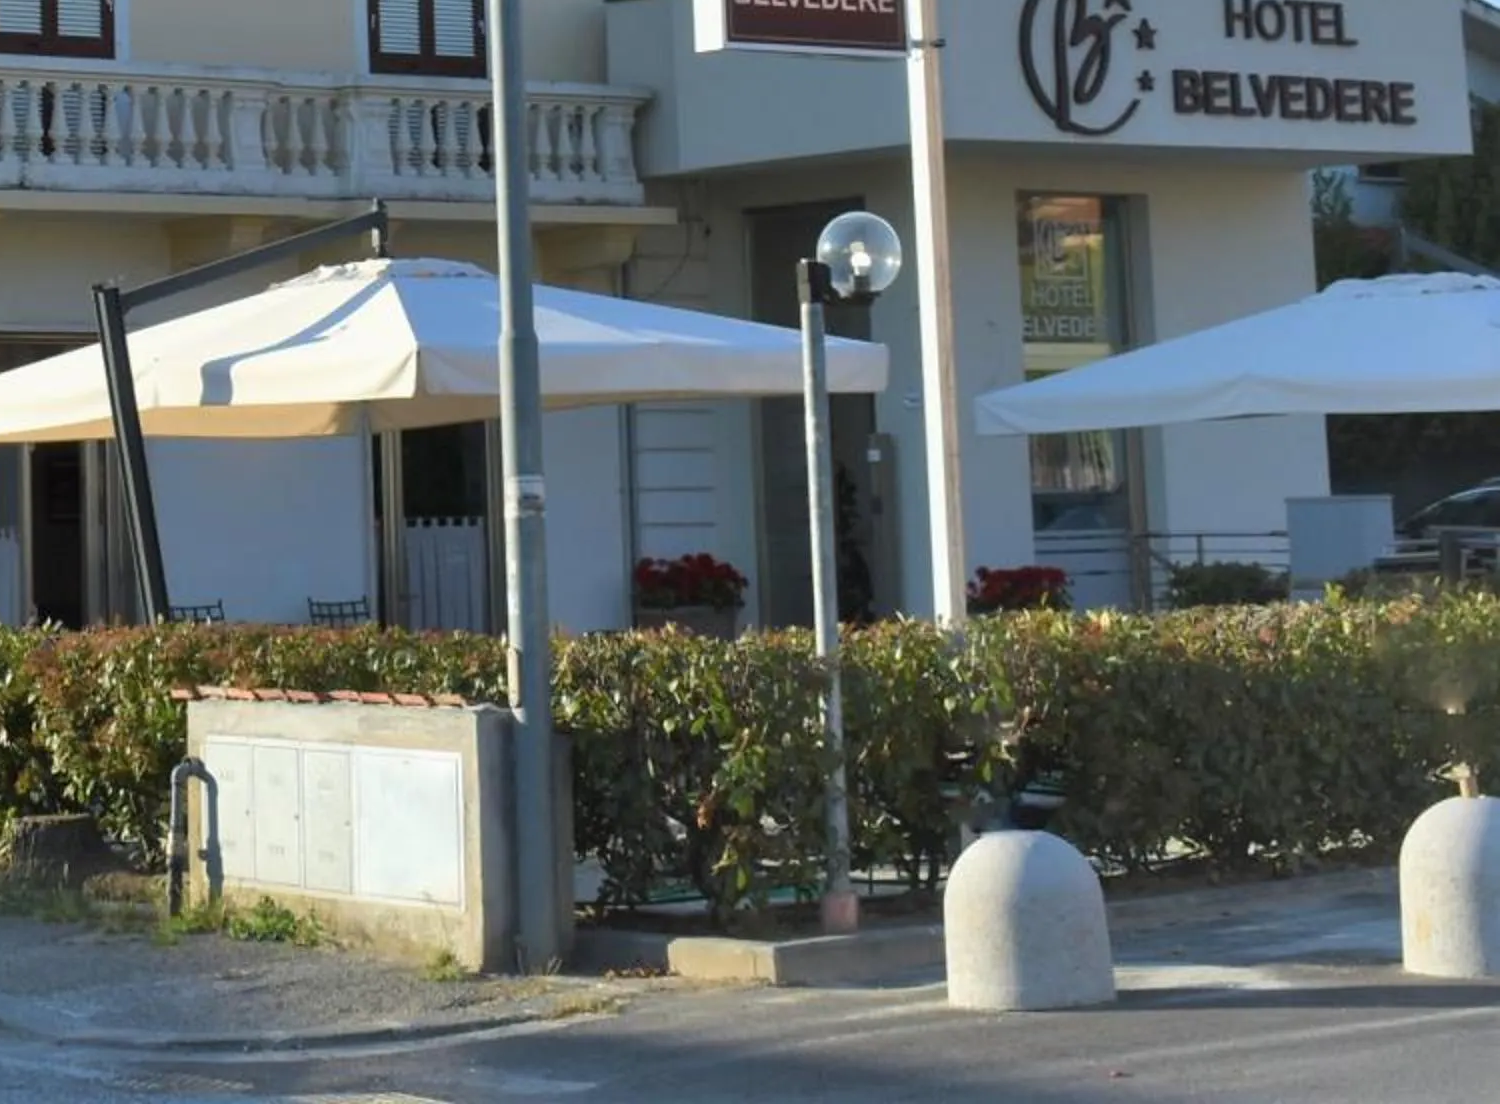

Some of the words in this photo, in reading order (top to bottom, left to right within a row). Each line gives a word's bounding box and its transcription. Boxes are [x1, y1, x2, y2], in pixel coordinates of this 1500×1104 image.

[1171, 68, 1417, 126] BELVEDERE
[1031, 284, 1093, 307] HOTEL
[1021, 314, 1098, 336] ELVEDE
